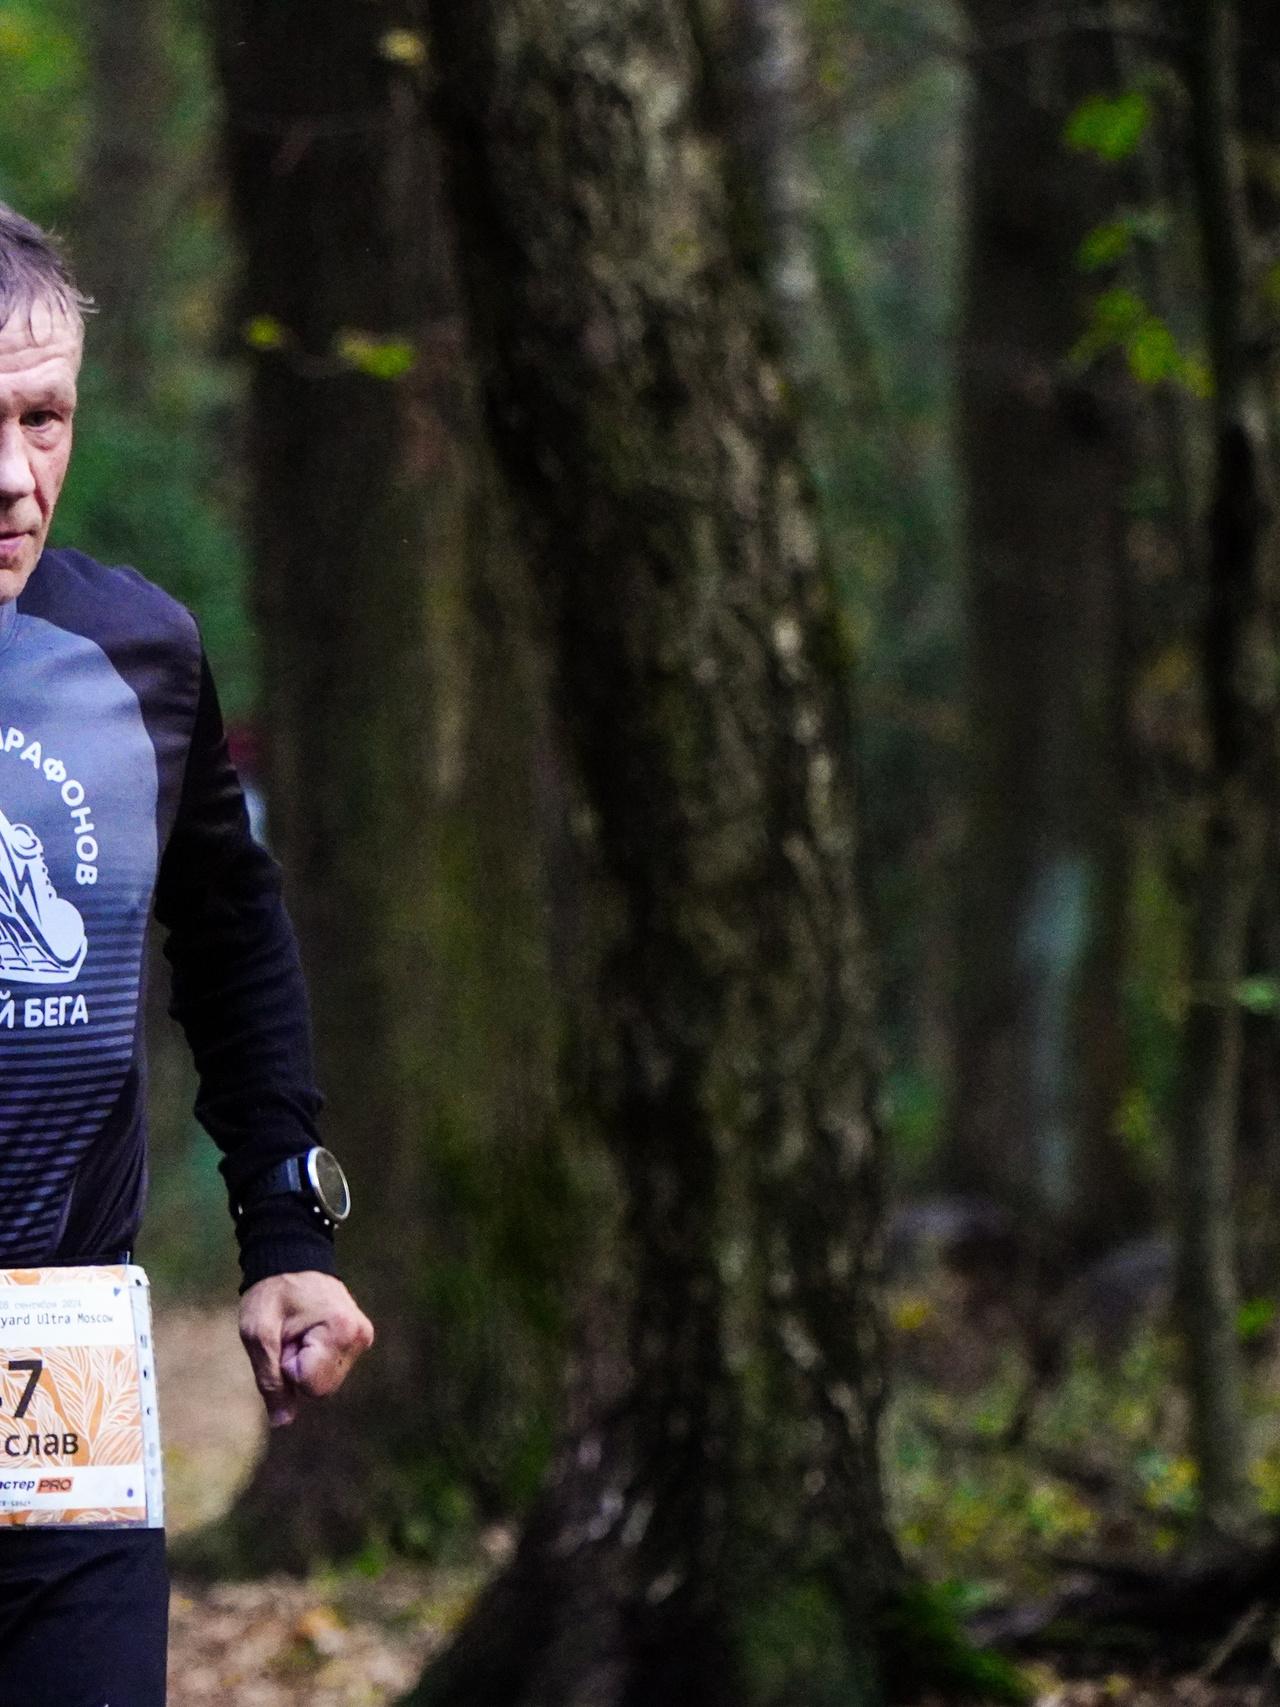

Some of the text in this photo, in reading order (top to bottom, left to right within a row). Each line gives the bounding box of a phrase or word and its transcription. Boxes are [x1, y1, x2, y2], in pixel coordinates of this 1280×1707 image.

[24, 994, 89, 1028] БЕГА
[37, 1313, 71, 1325] Ultra
[77, 1313, 114, 1324] Moscow
[37, 1478, 73, 1493] PRO
